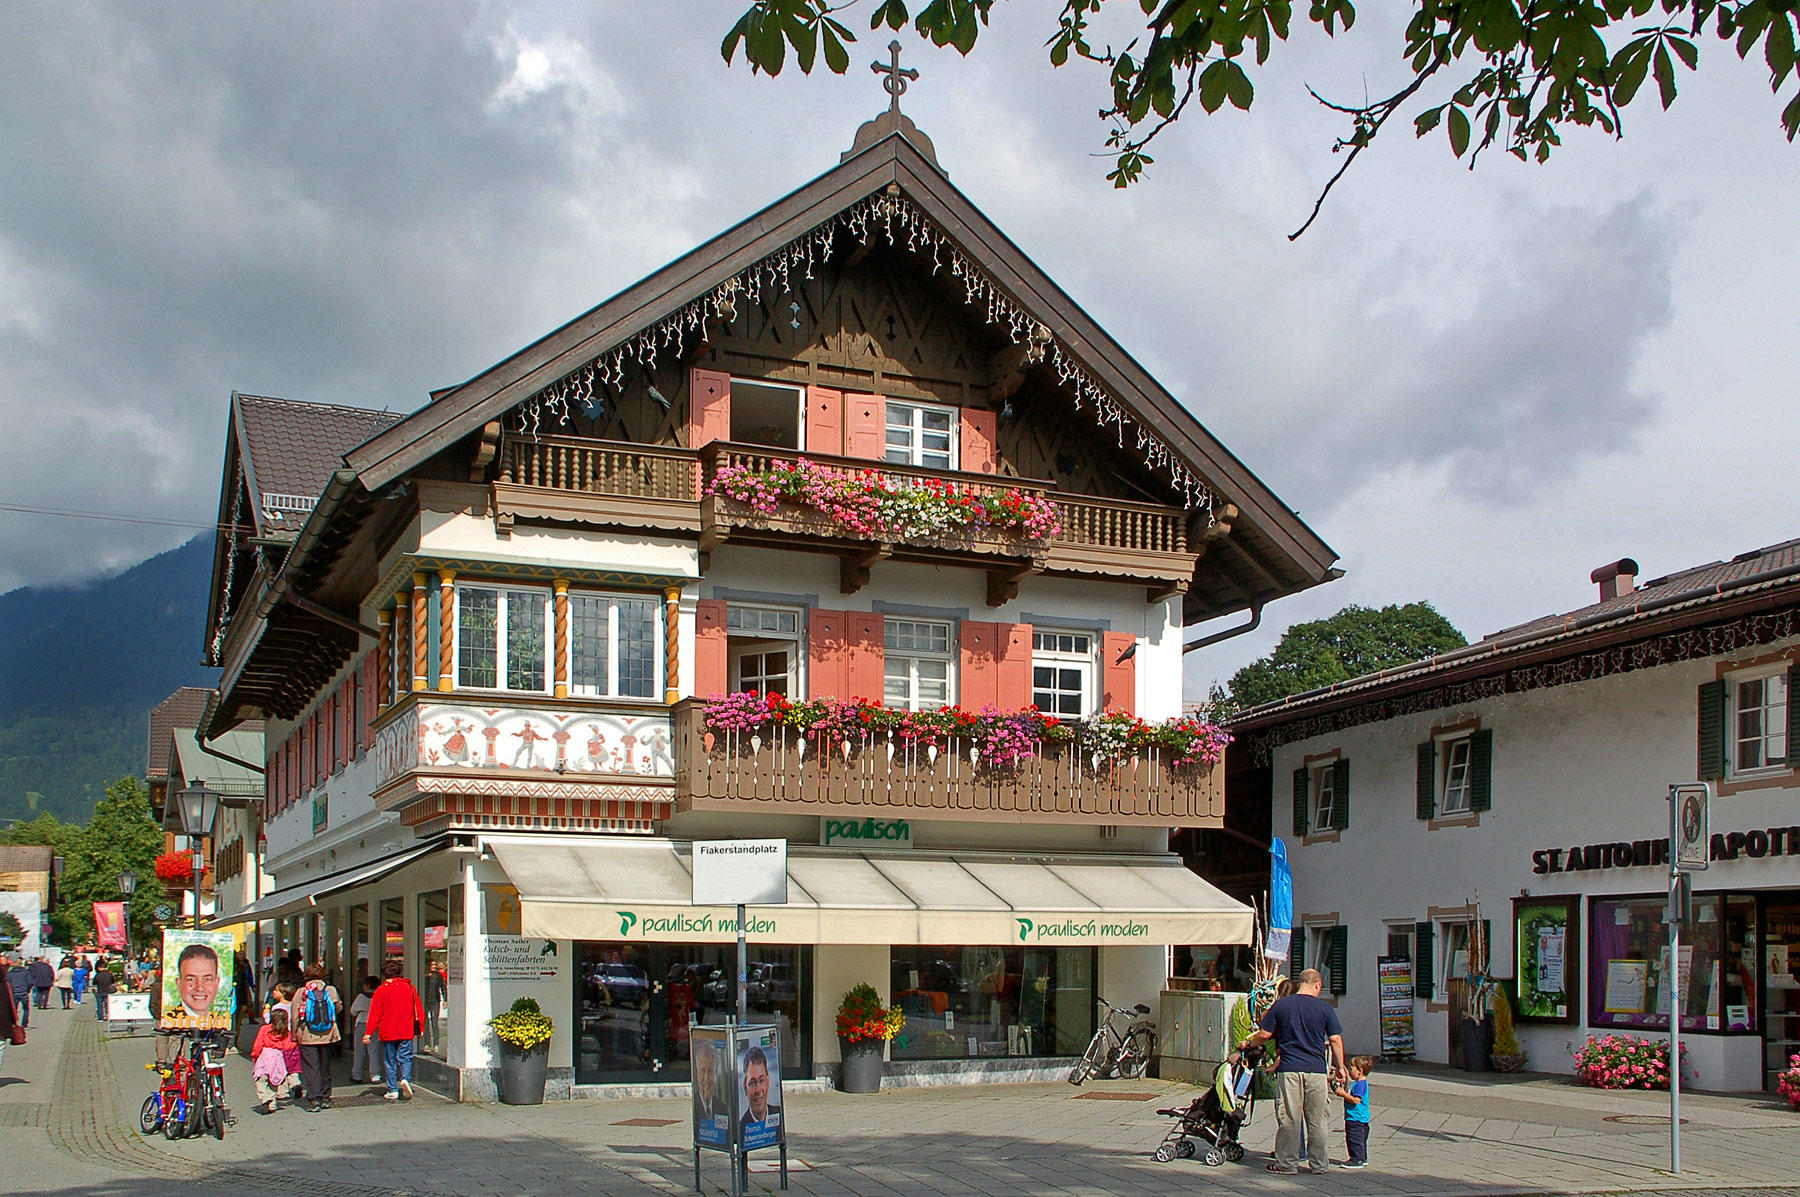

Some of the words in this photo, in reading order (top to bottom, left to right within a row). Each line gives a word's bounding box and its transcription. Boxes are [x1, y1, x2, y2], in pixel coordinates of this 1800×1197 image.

[826, 817, 909, 845] paulisch
[700, 845, 778, 855] Fiakerstandplatz
[1565, 838, 1669, 871] ANTONI
[642, 914, 713, 936] paulisch
[1038, 919, 1096, 940] paulisch
[1101, 919, 1148, 936] moden
[514, 945, 531, 953] und
